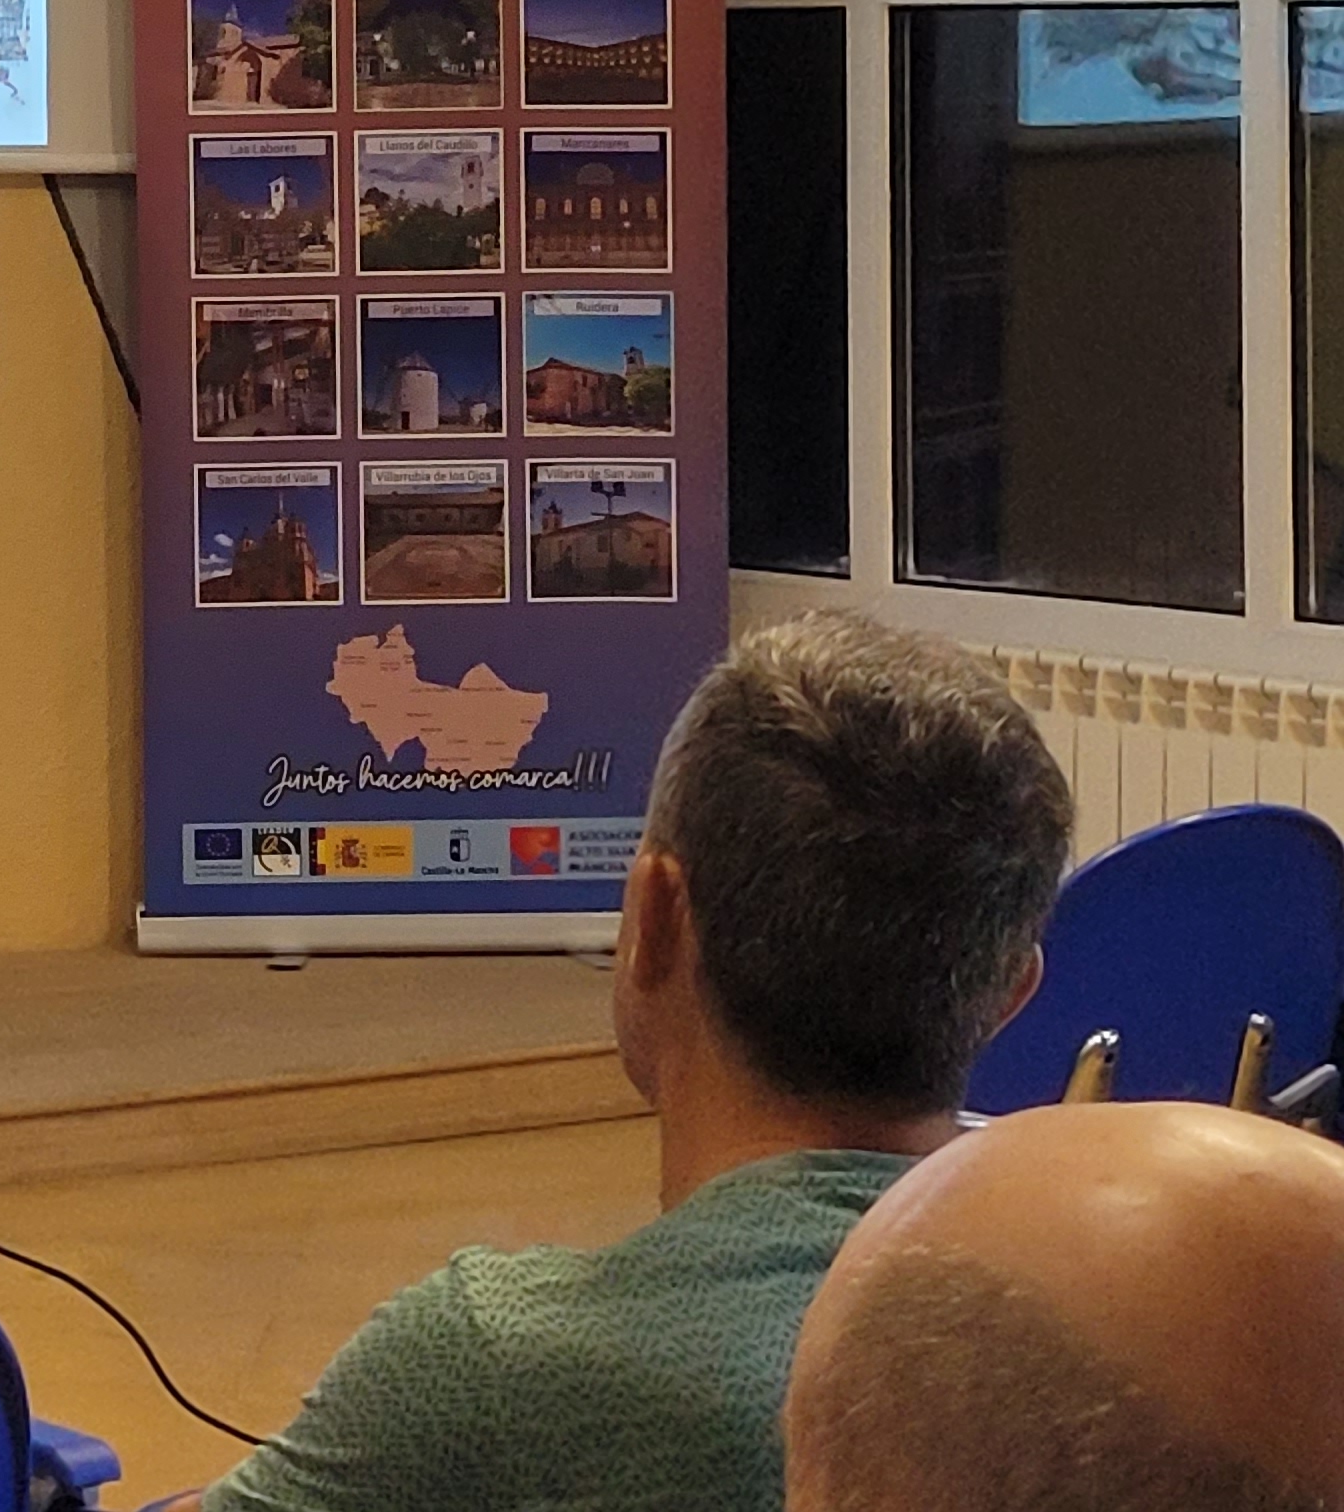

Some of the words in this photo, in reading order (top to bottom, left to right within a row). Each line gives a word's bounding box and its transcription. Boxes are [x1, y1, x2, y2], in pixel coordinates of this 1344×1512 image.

[262, 755, 350, 808] Juntos
[355, 755, 461, 790] hacemos
[469, 751, 612, 792] comarca!!!
